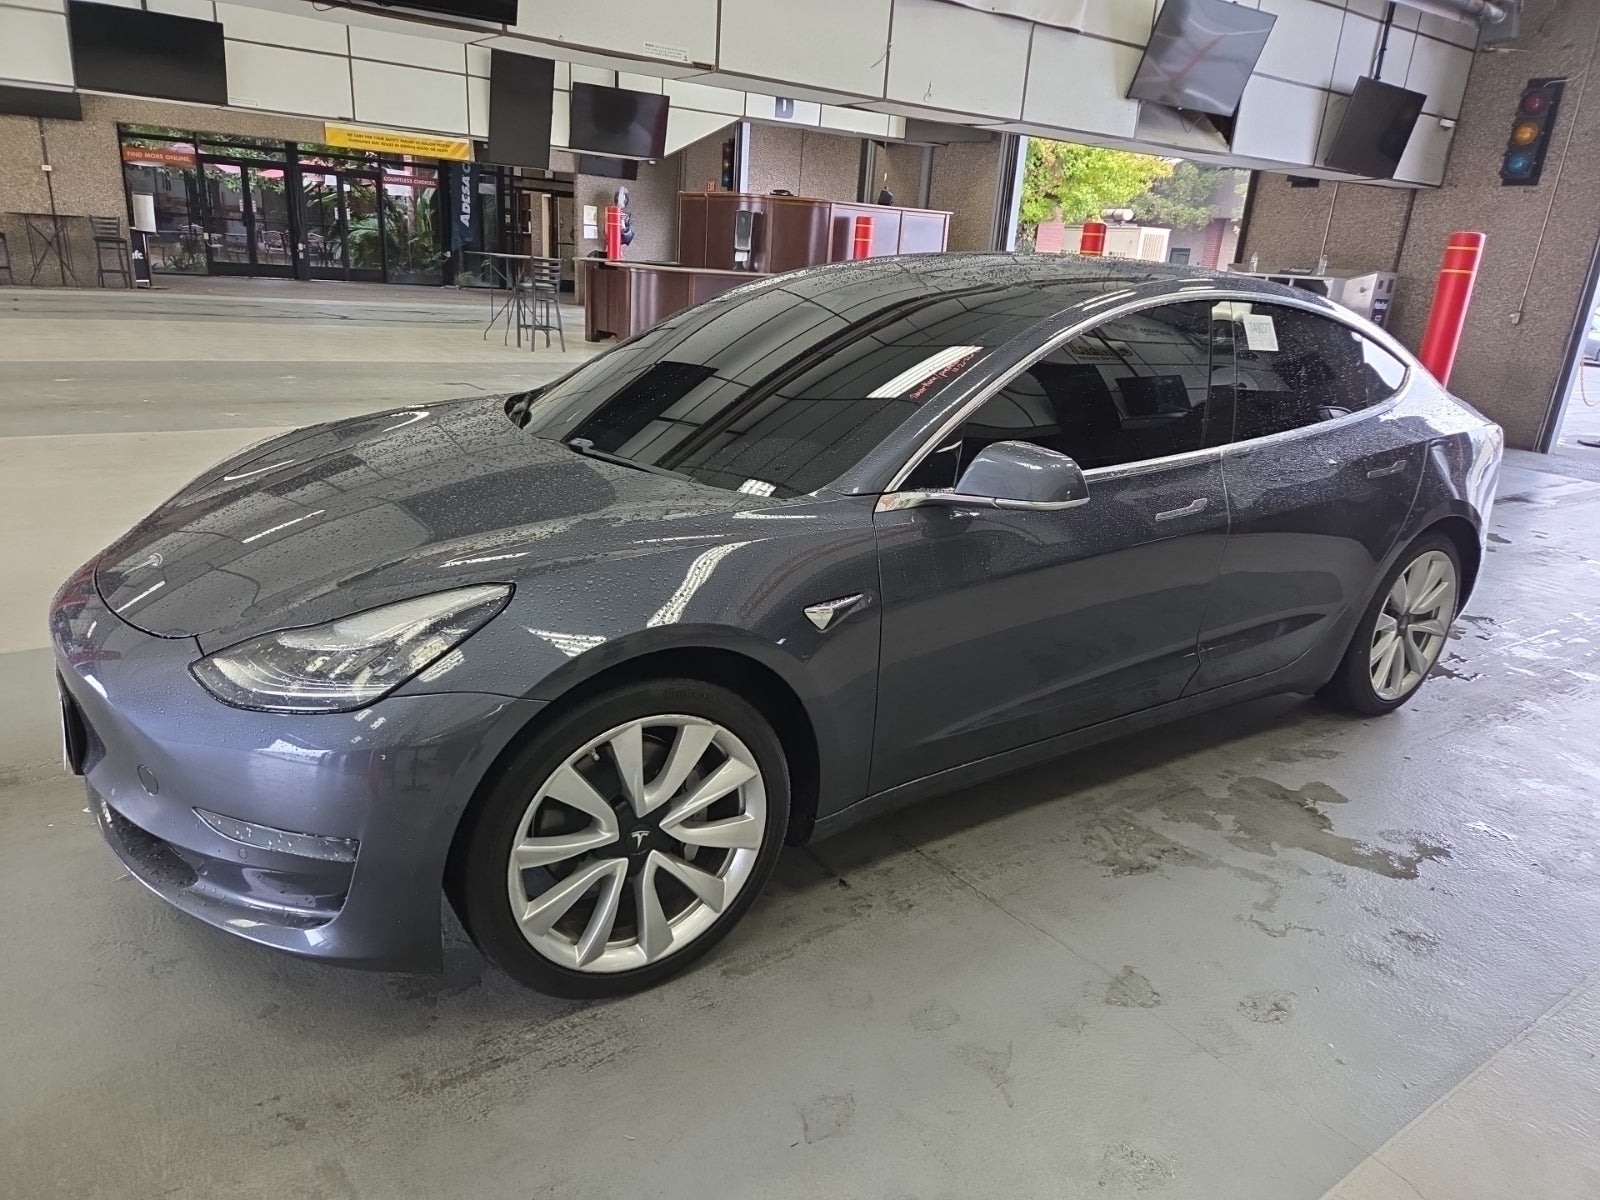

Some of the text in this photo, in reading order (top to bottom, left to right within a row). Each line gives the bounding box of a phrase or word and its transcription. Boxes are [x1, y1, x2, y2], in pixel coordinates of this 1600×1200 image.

[775, 96, 794, 119] D
[144, 152, 163, 160] MORE
[165, 154, 192, 162] ONLINE.
[383, 176, 413, 184] COUNTLESS
[459, 176, 471, 228] ADESA
